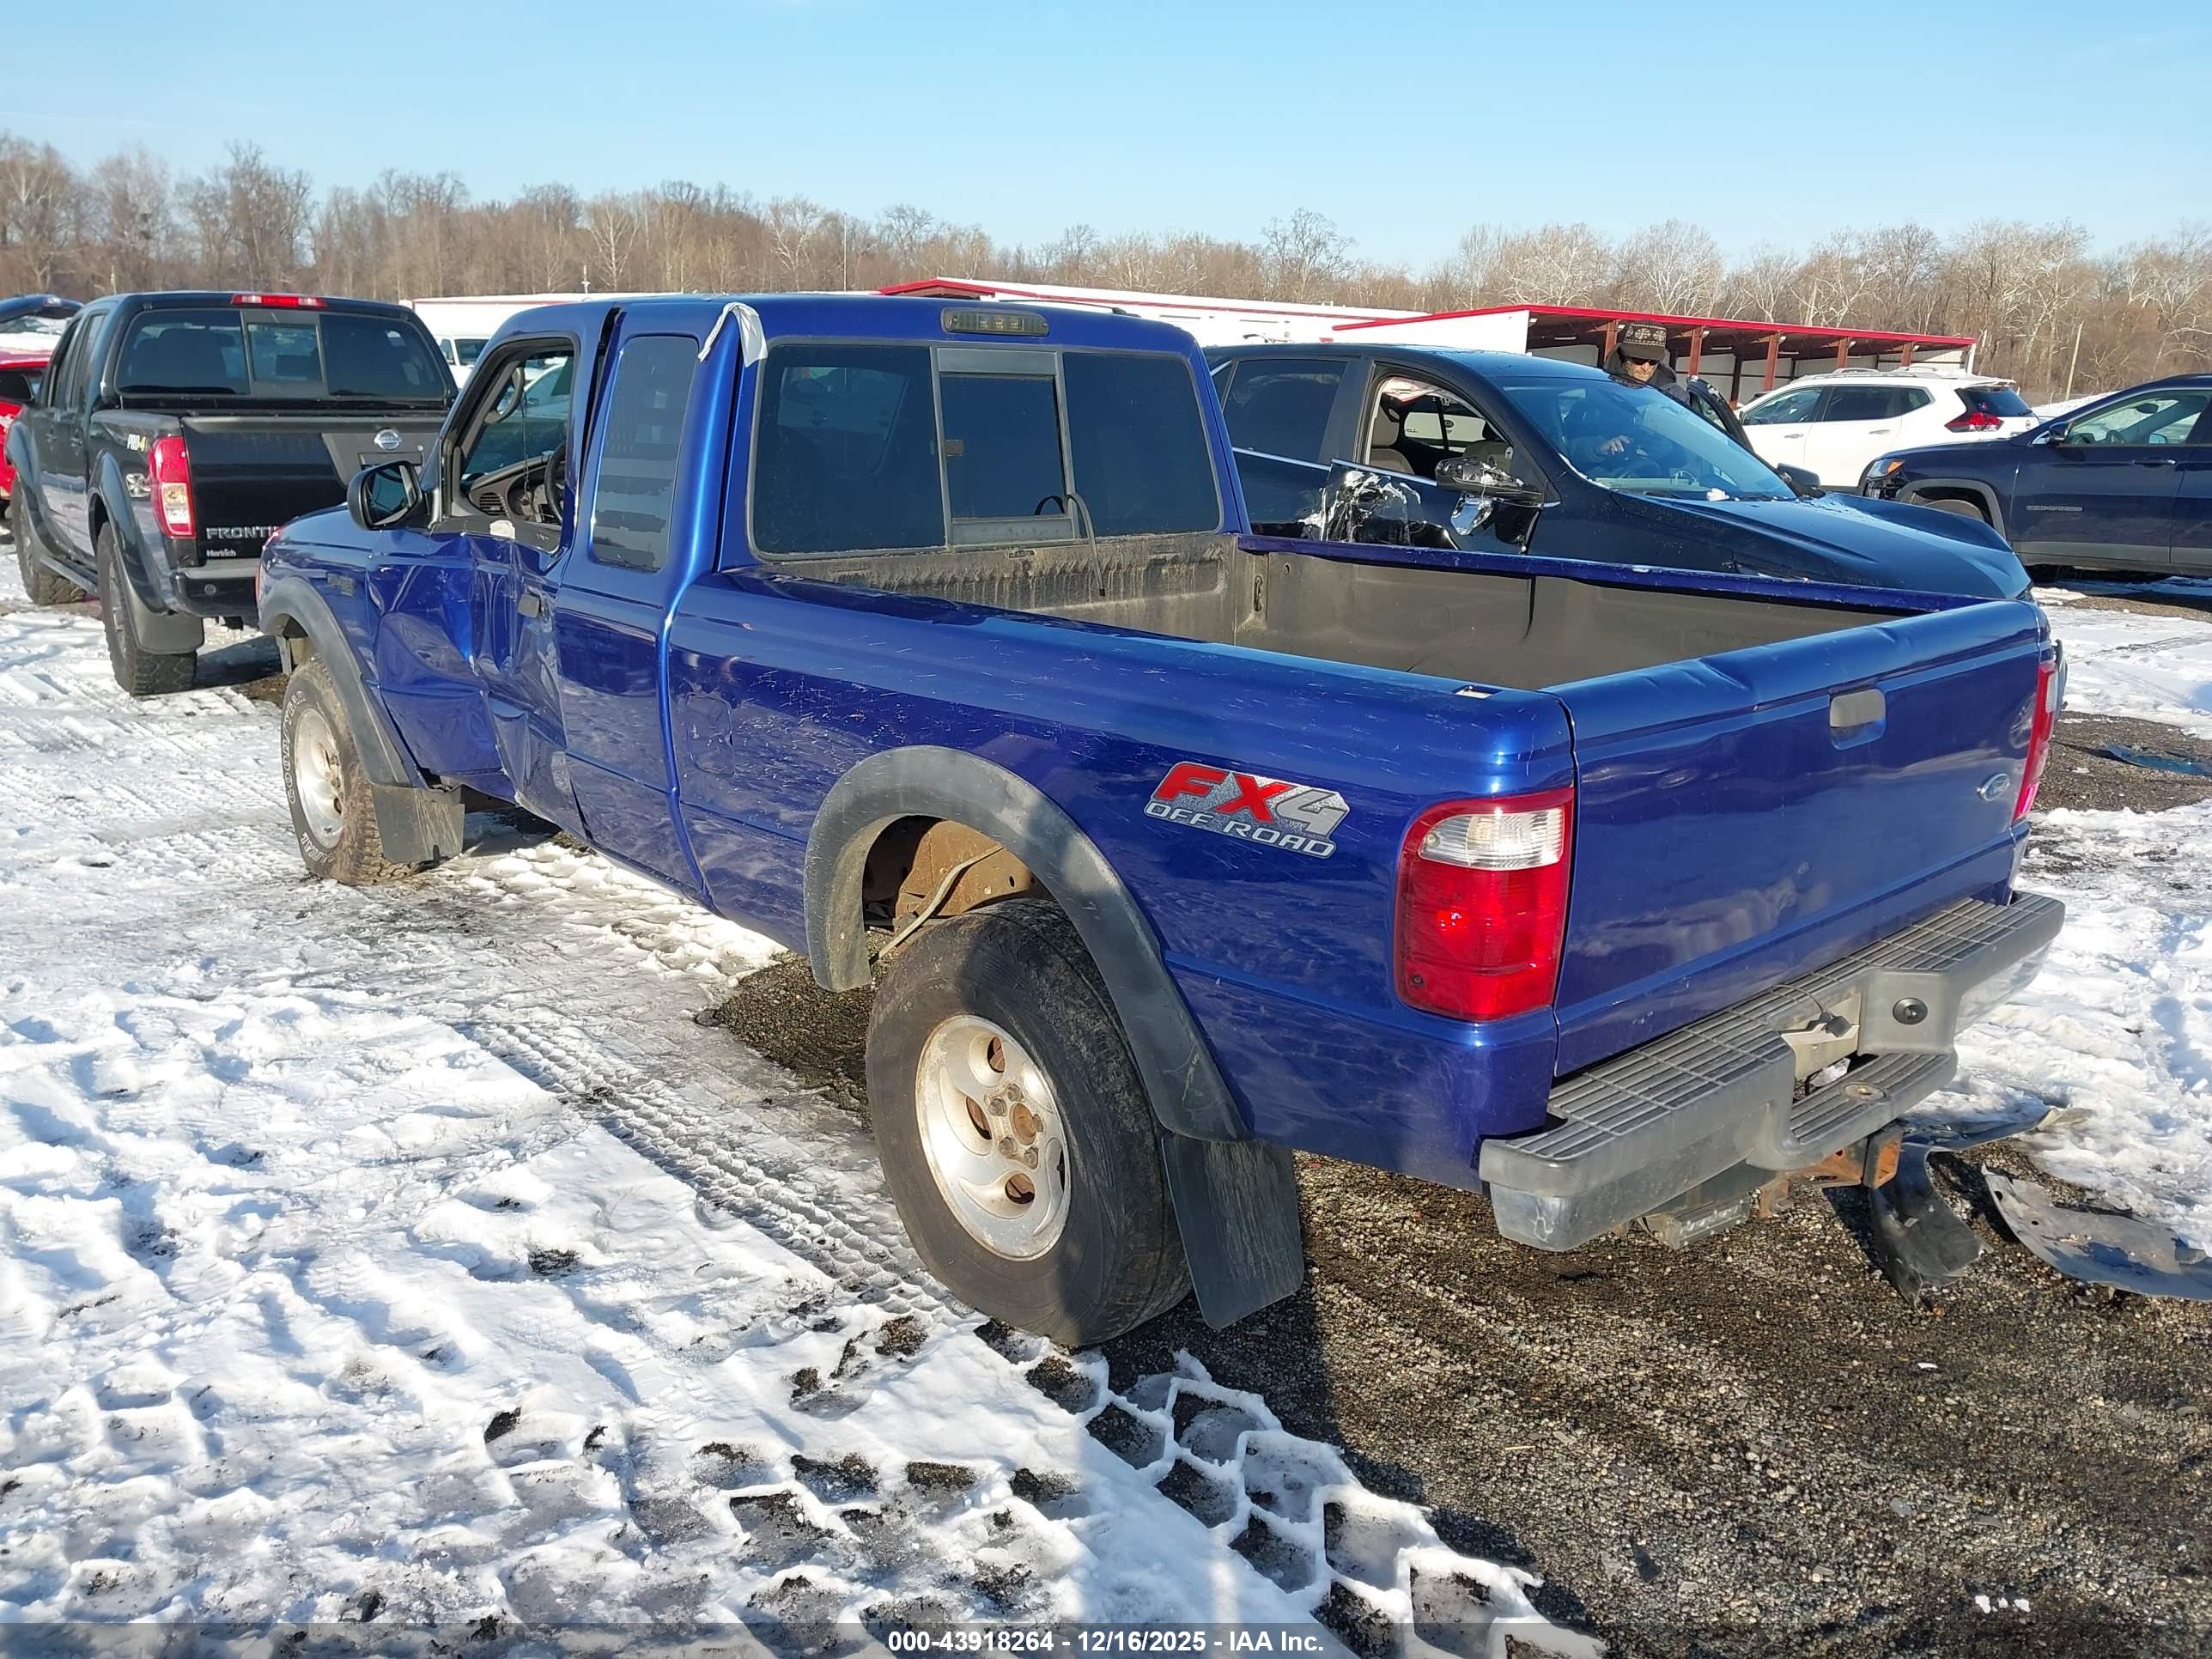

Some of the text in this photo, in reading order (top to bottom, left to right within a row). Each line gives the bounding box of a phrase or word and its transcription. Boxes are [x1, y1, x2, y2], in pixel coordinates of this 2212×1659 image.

[1146, 801, 1334, 856] OFF ROAD
[1154, 762, 1350, 837] FX4
